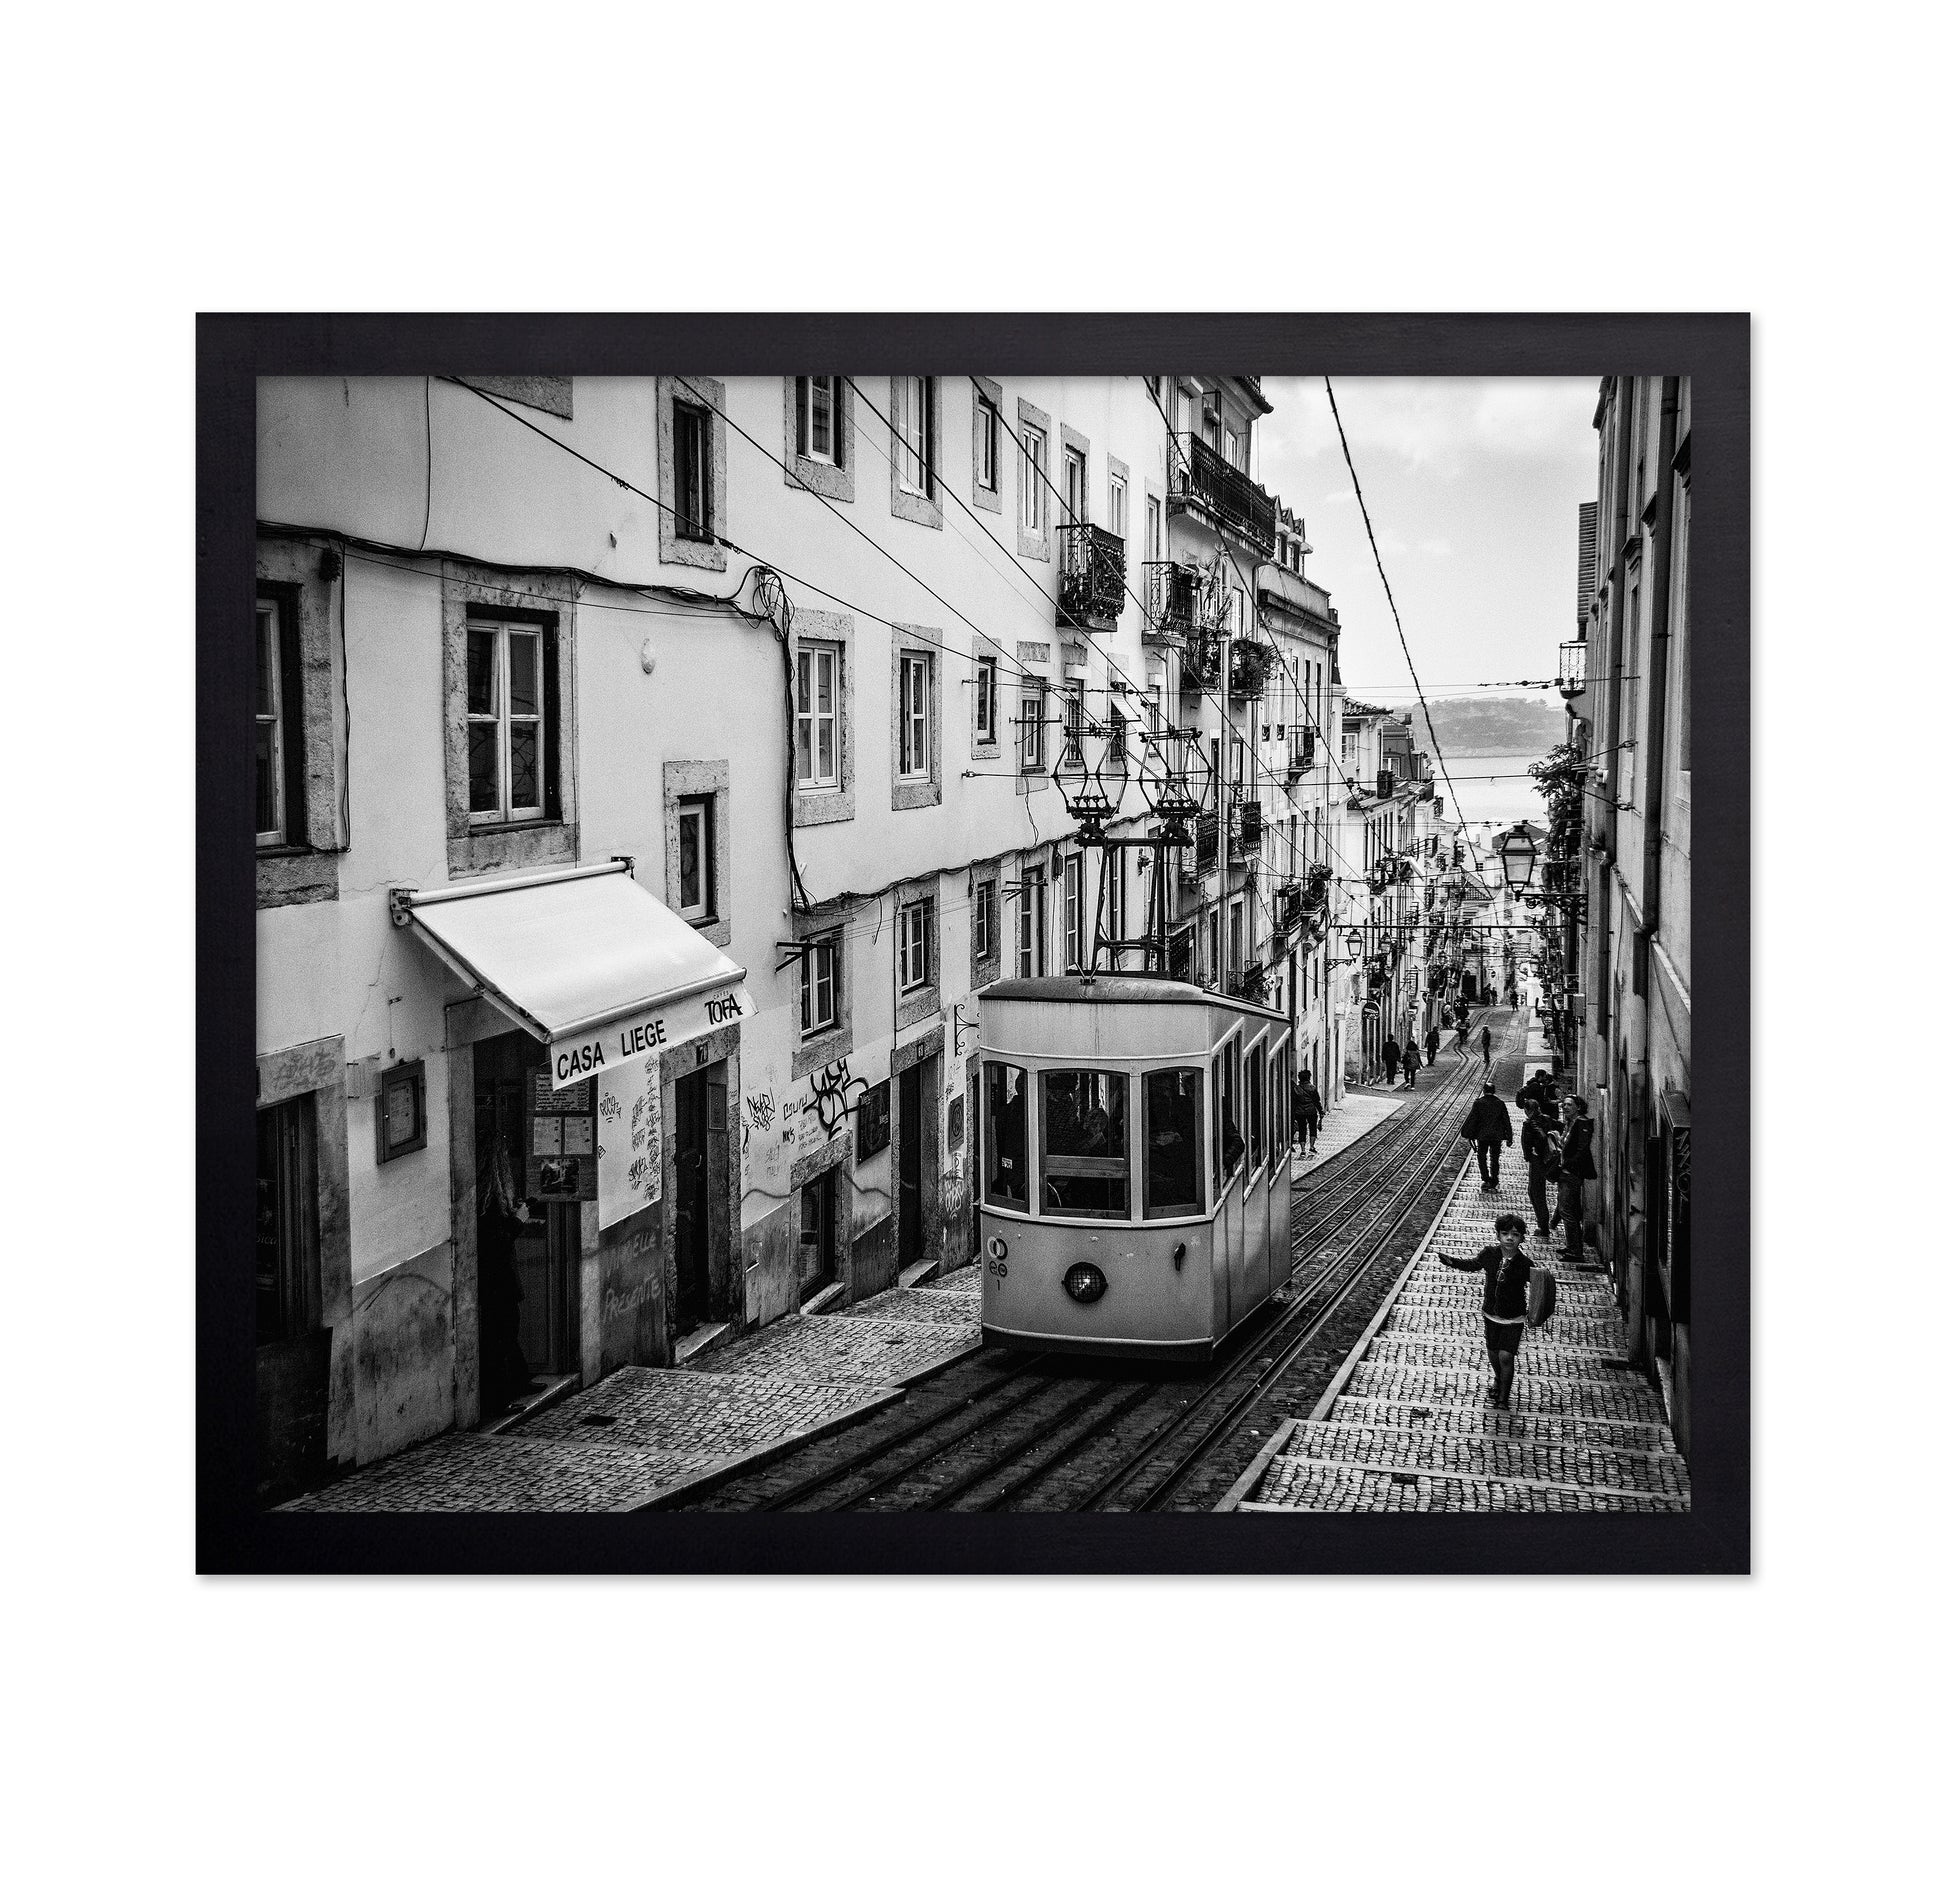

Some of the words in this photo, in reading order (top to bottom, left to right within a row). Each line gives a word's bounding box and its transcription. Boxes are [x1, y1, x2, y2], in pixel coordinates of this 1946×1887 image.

[704, 993, 743, 1025] TOFA
[557, 1042, 605, 1080] CASA
[621, 1019, 667, 1057] LIEGE
